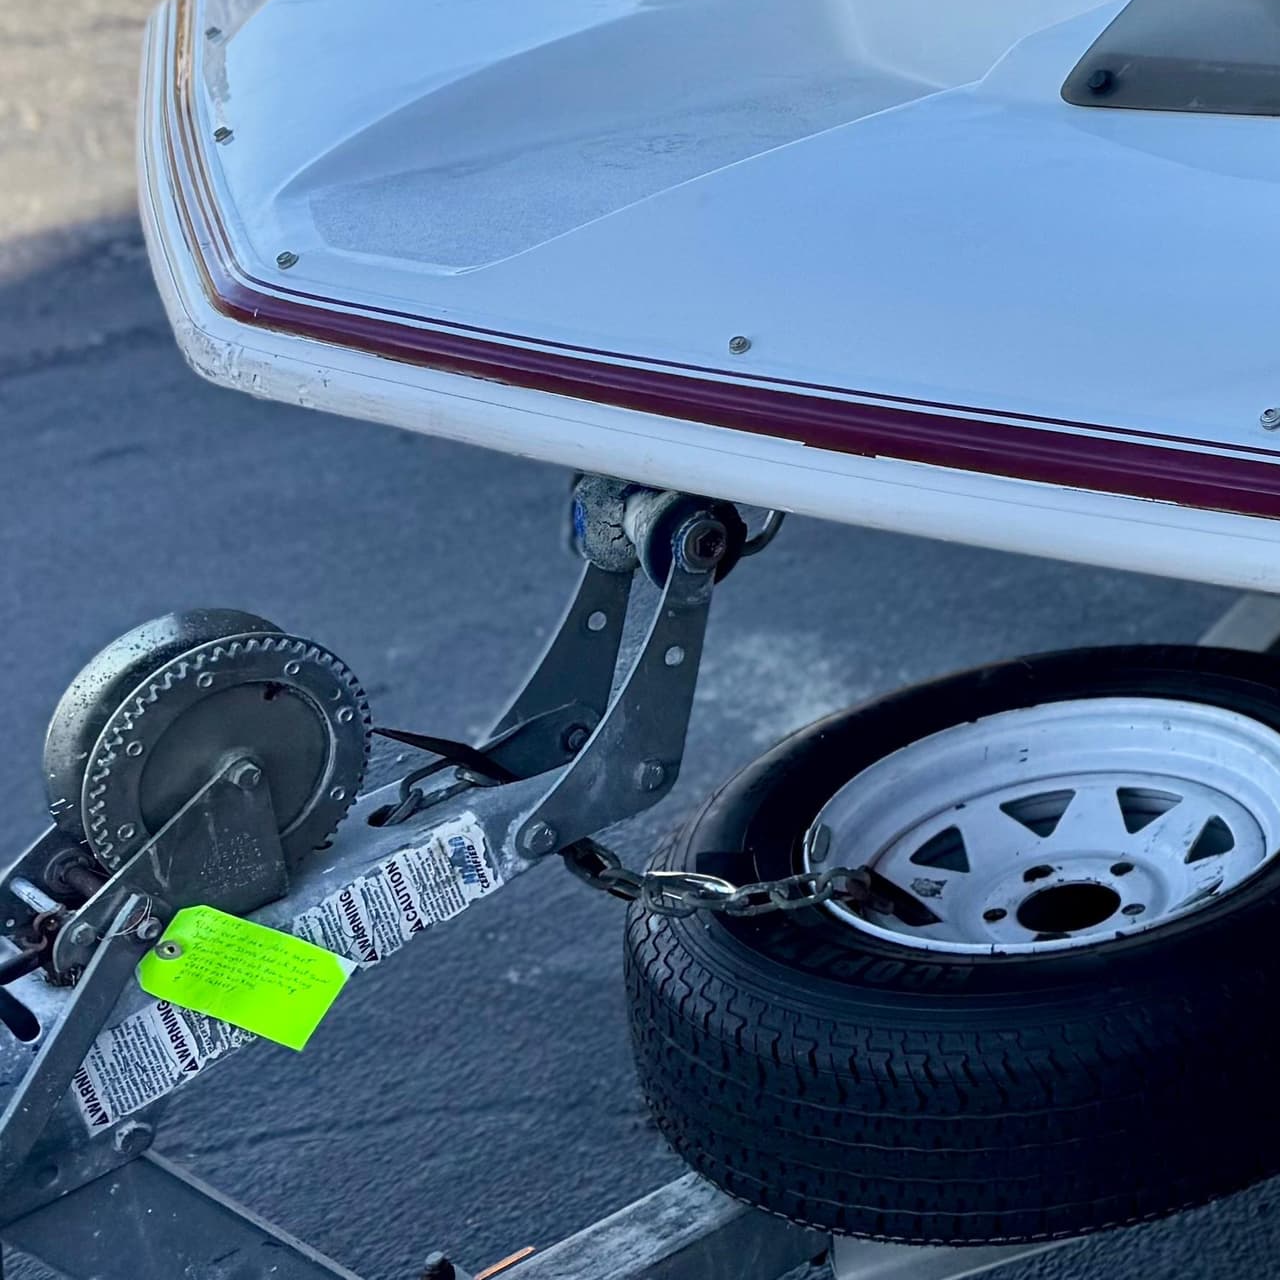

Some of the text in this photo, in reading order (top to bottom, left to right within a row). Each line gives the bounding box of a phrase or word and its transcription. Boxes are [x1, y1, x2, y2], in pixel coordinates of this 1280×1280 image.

[385, 860, 418, 922] CAUTION
[466, 844, 491, 889] CERTIFIED
[339, 889, 371, 953] WARNING
[157, 1000, 193, 1064] WARNING
